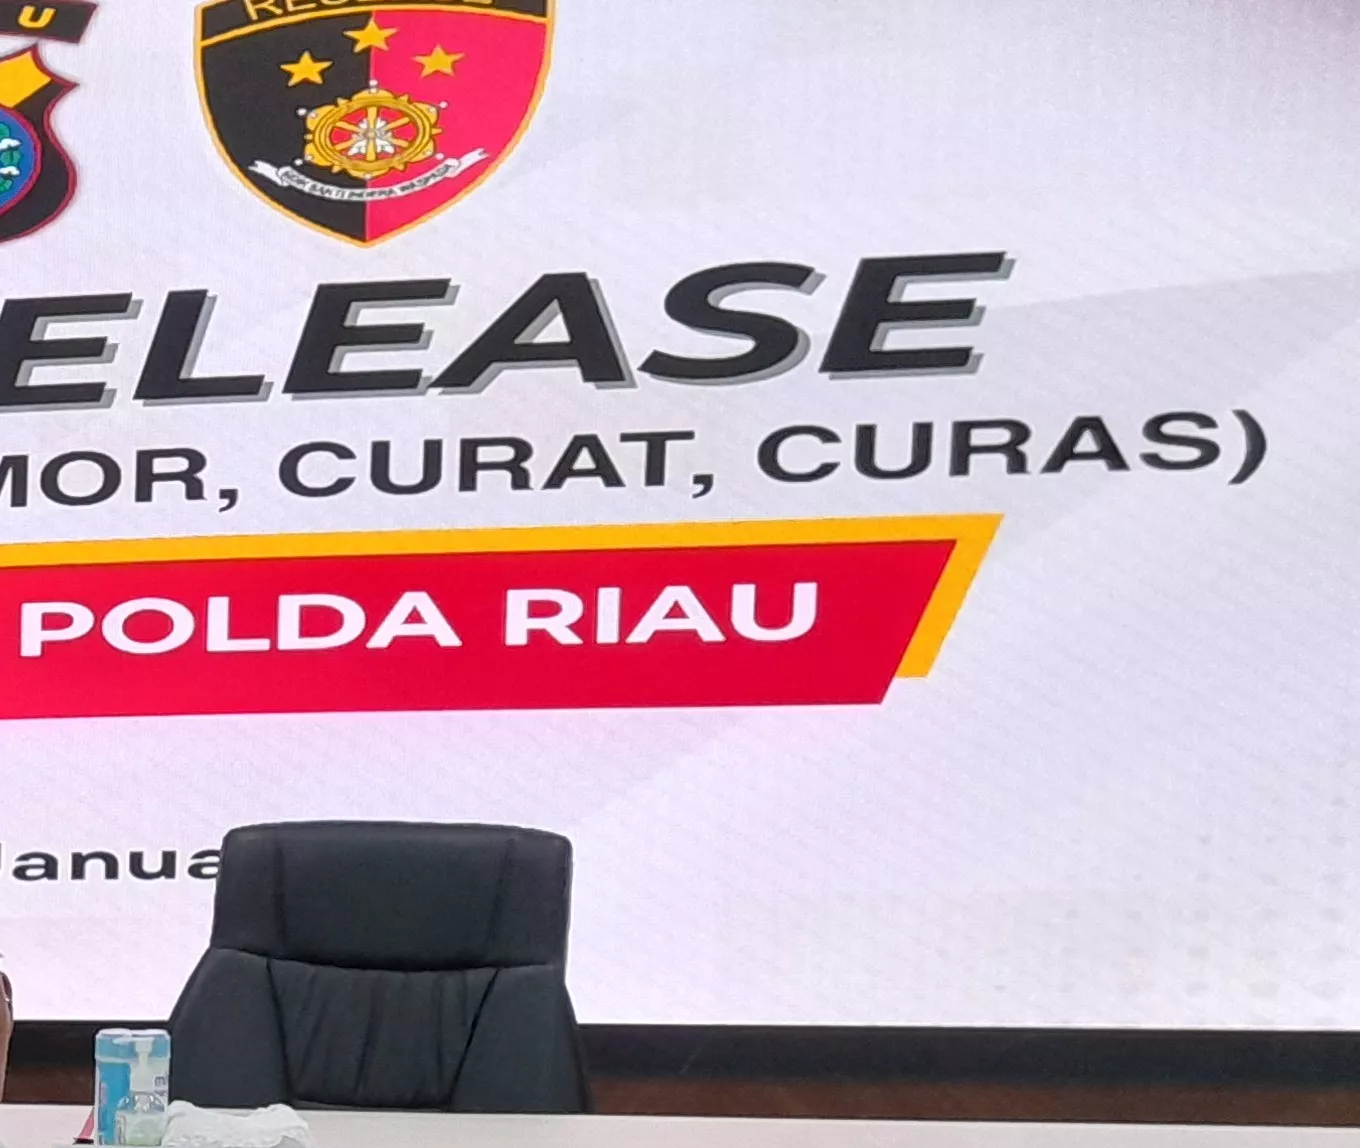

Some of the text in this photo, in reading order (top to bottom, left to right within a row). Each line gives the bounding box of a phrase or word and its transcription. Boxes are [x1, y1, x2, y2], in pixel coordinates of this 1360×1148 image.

[279, 431, 713, 499] CURAT,
[758, 410, 1267, 484] CURAS)
[20, 591, 462, 657] POLDA
[505, 582, 817, 646] RIAU
